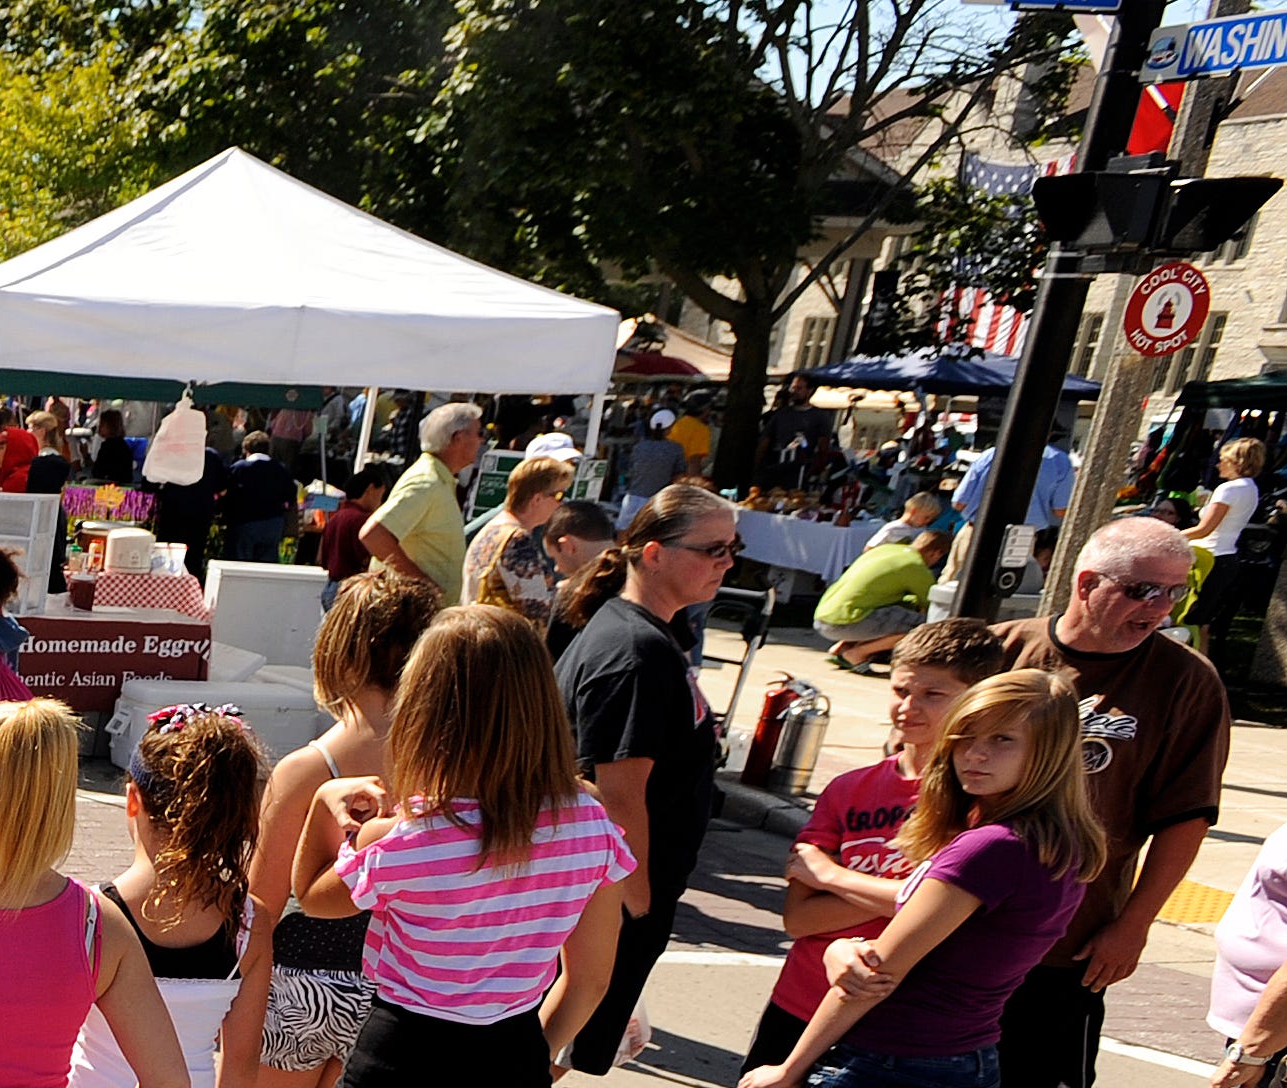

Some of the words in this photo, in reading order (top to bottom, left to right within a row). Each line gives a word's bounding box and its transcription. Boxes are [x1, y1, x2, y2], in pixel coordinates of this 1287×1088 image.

[1140, 267, 1178, 295] COOL
[1181, 269, 1207, 296] CITY
[1129, 328, 1154, 351] HOT
[1153, 330, 1188, 354] SPOT
[17, 635, 137, 654] Homemade
[69, 671, 116, 687] Asian
